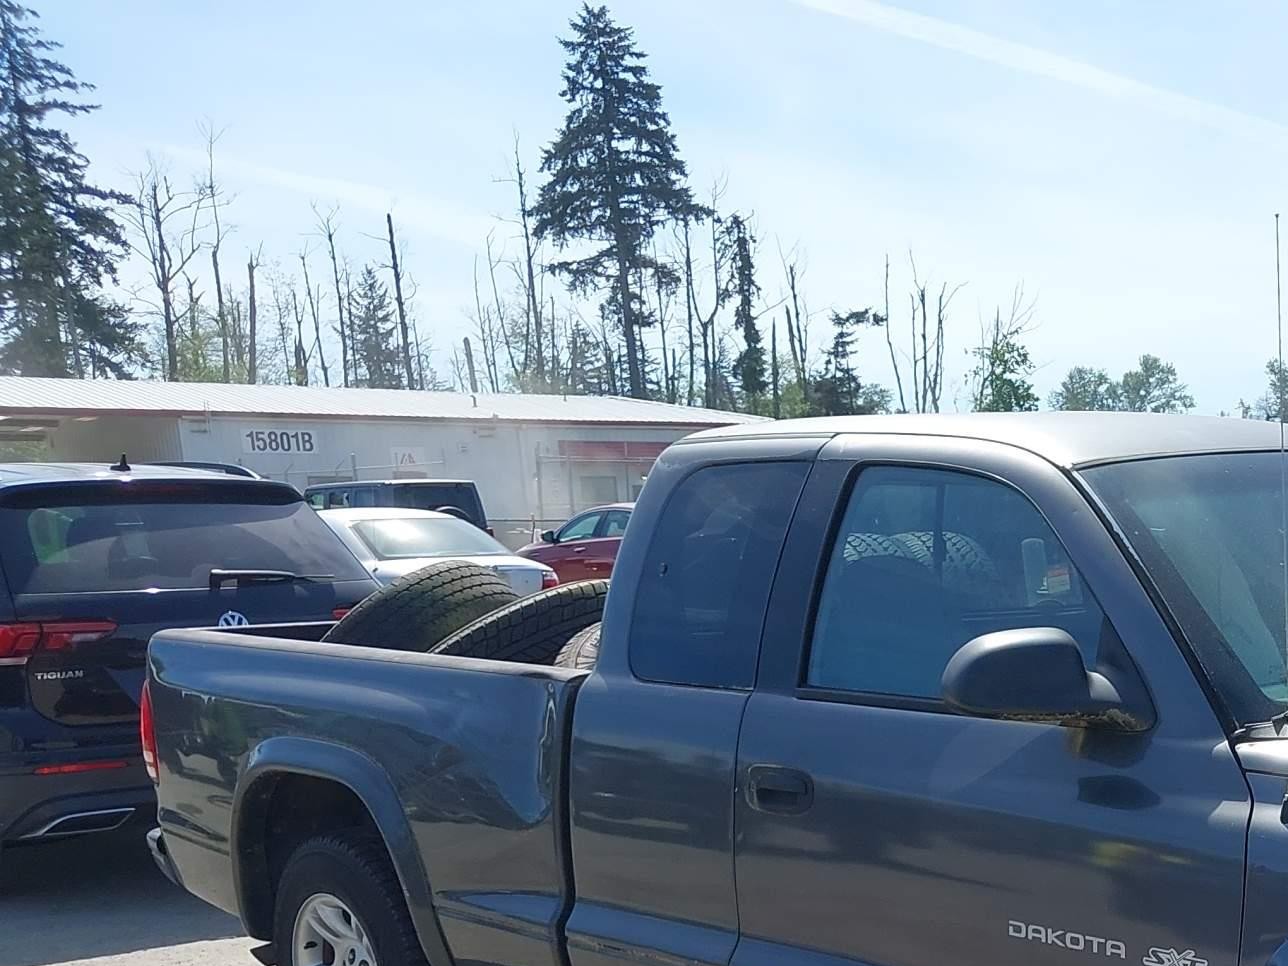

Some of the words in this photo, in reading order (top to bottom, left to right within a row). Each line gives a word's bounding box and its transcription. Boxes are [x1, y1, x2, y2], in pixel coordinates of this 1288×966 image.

[245, 430, 314, 452] 15801B
[34, 669, 84, 681] TIGUAN
[1008, 919, 1126, 959] DAKOTA
